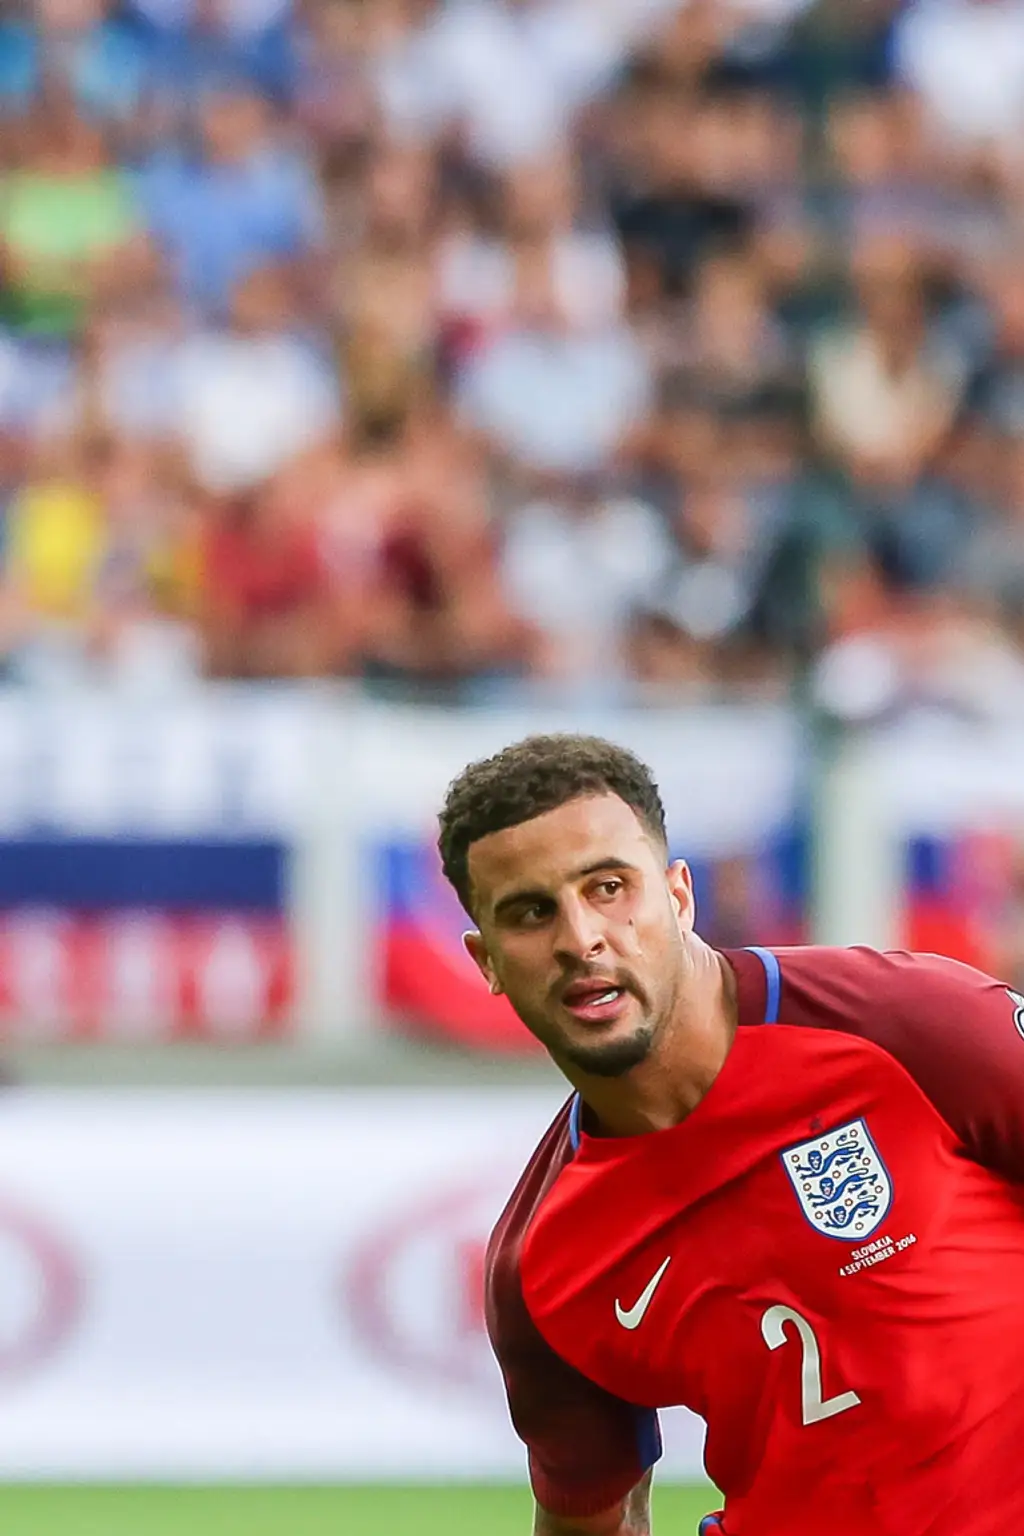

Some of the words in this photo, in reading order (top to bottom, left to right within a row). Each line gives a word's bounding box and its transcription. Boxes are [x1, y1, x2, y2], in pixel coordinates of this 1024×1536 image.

[845, 1246, 896, 1275] SEPTEMBER
[895, 1233, 917, 1251] 2016
[851, 1235, 893, 1260] SLOVAKIA
[761, 1304, 862, 1426] 2
